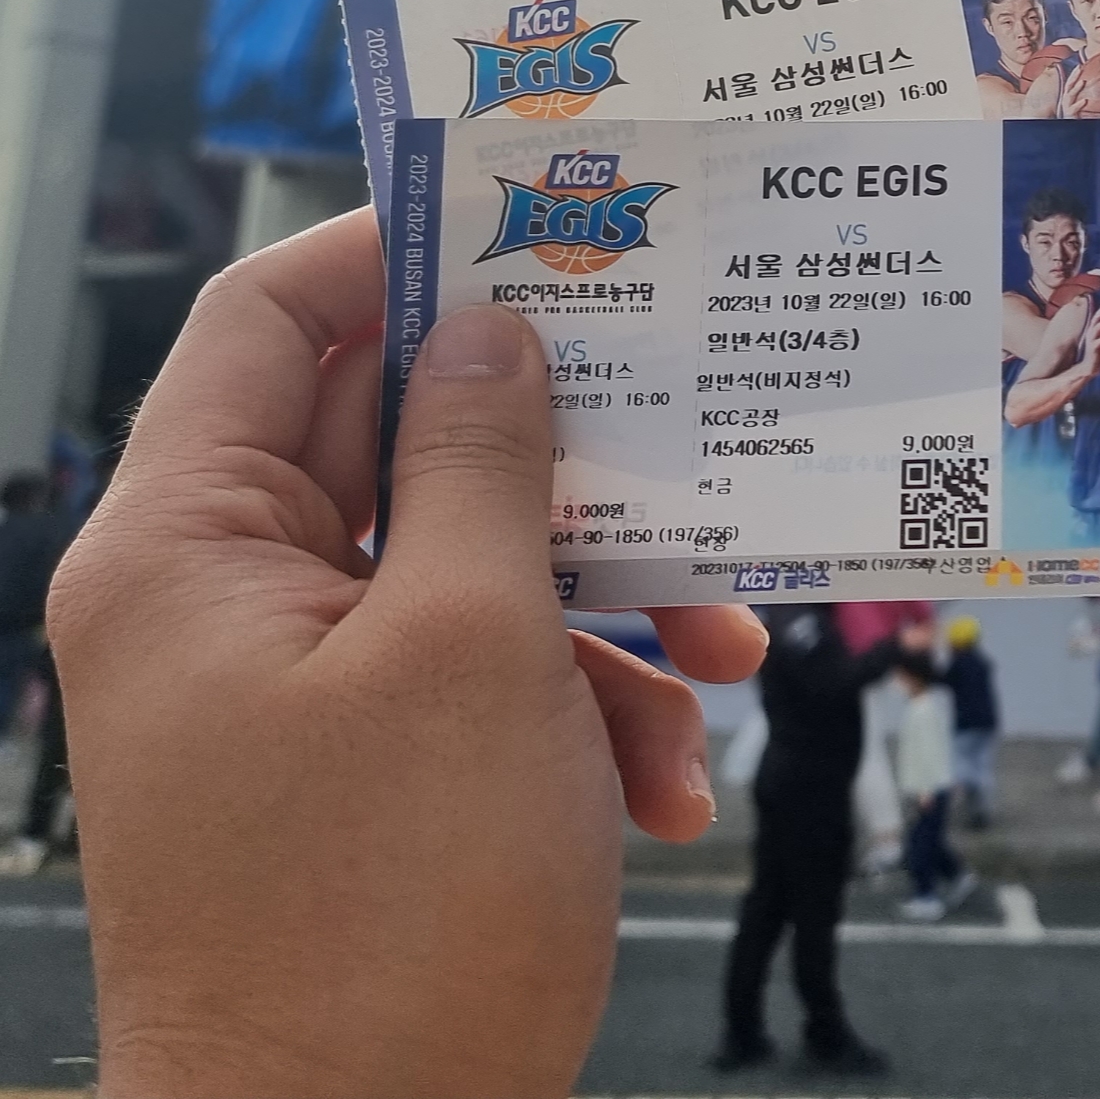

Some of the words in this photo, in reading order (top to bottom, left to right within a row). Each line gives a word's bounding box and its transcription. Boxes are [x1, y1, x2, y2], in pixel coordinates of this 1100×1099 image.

[803, 31, 837, 55] VS
[365, 28, 398, 118] 2023-2024
[453, 18, 641, 118] EGIS
[703, 72, 759, 102] 서울
[770, 47, 915, 92] 삼성썬더스
[810, 90, 886, 118] 22일(일)
[899, 79, 949, 102] 16:00
[552, 150, 612, 186] KCC
[761, 166, 844, 199] KCC
[857, 164, 949, 197] EGIS
[406, 154, 429, 243] 2023-2024
[471, 173, 681, 265] EGIS
[836, 223, 869, 246] VS
[404, 248, 425, 303] BUSAN
[724, 254, 783, 279] 서울
[796, 250, 943, 278] 삼성썬더스
[491, 282, 655, 303] KCC이지스프로농구단
[707, 295, 771, 314] 2023년
[782, 293, 821, 313] 10월
[829, 290, 907, 311] 22일(일)
[922, 289, 972, 308] 16:00
[402, 307, 421, 339] KCC
[554, 340, 587, 363] VS
[707, 328, 861, 353] 일반석(3/4층)
[547, 362, 635, 383] 성썬더스
[696, 369, 851, 393] 일반석(비지정석)
[626, 392, 671, 407] 16:00
[701, 408, 780, 428] KCC공장
[701, 438, 814, 458] 1454062565
[658, 525, 740, 545] (197/356)
[737, 569, 776, 590] KCC
